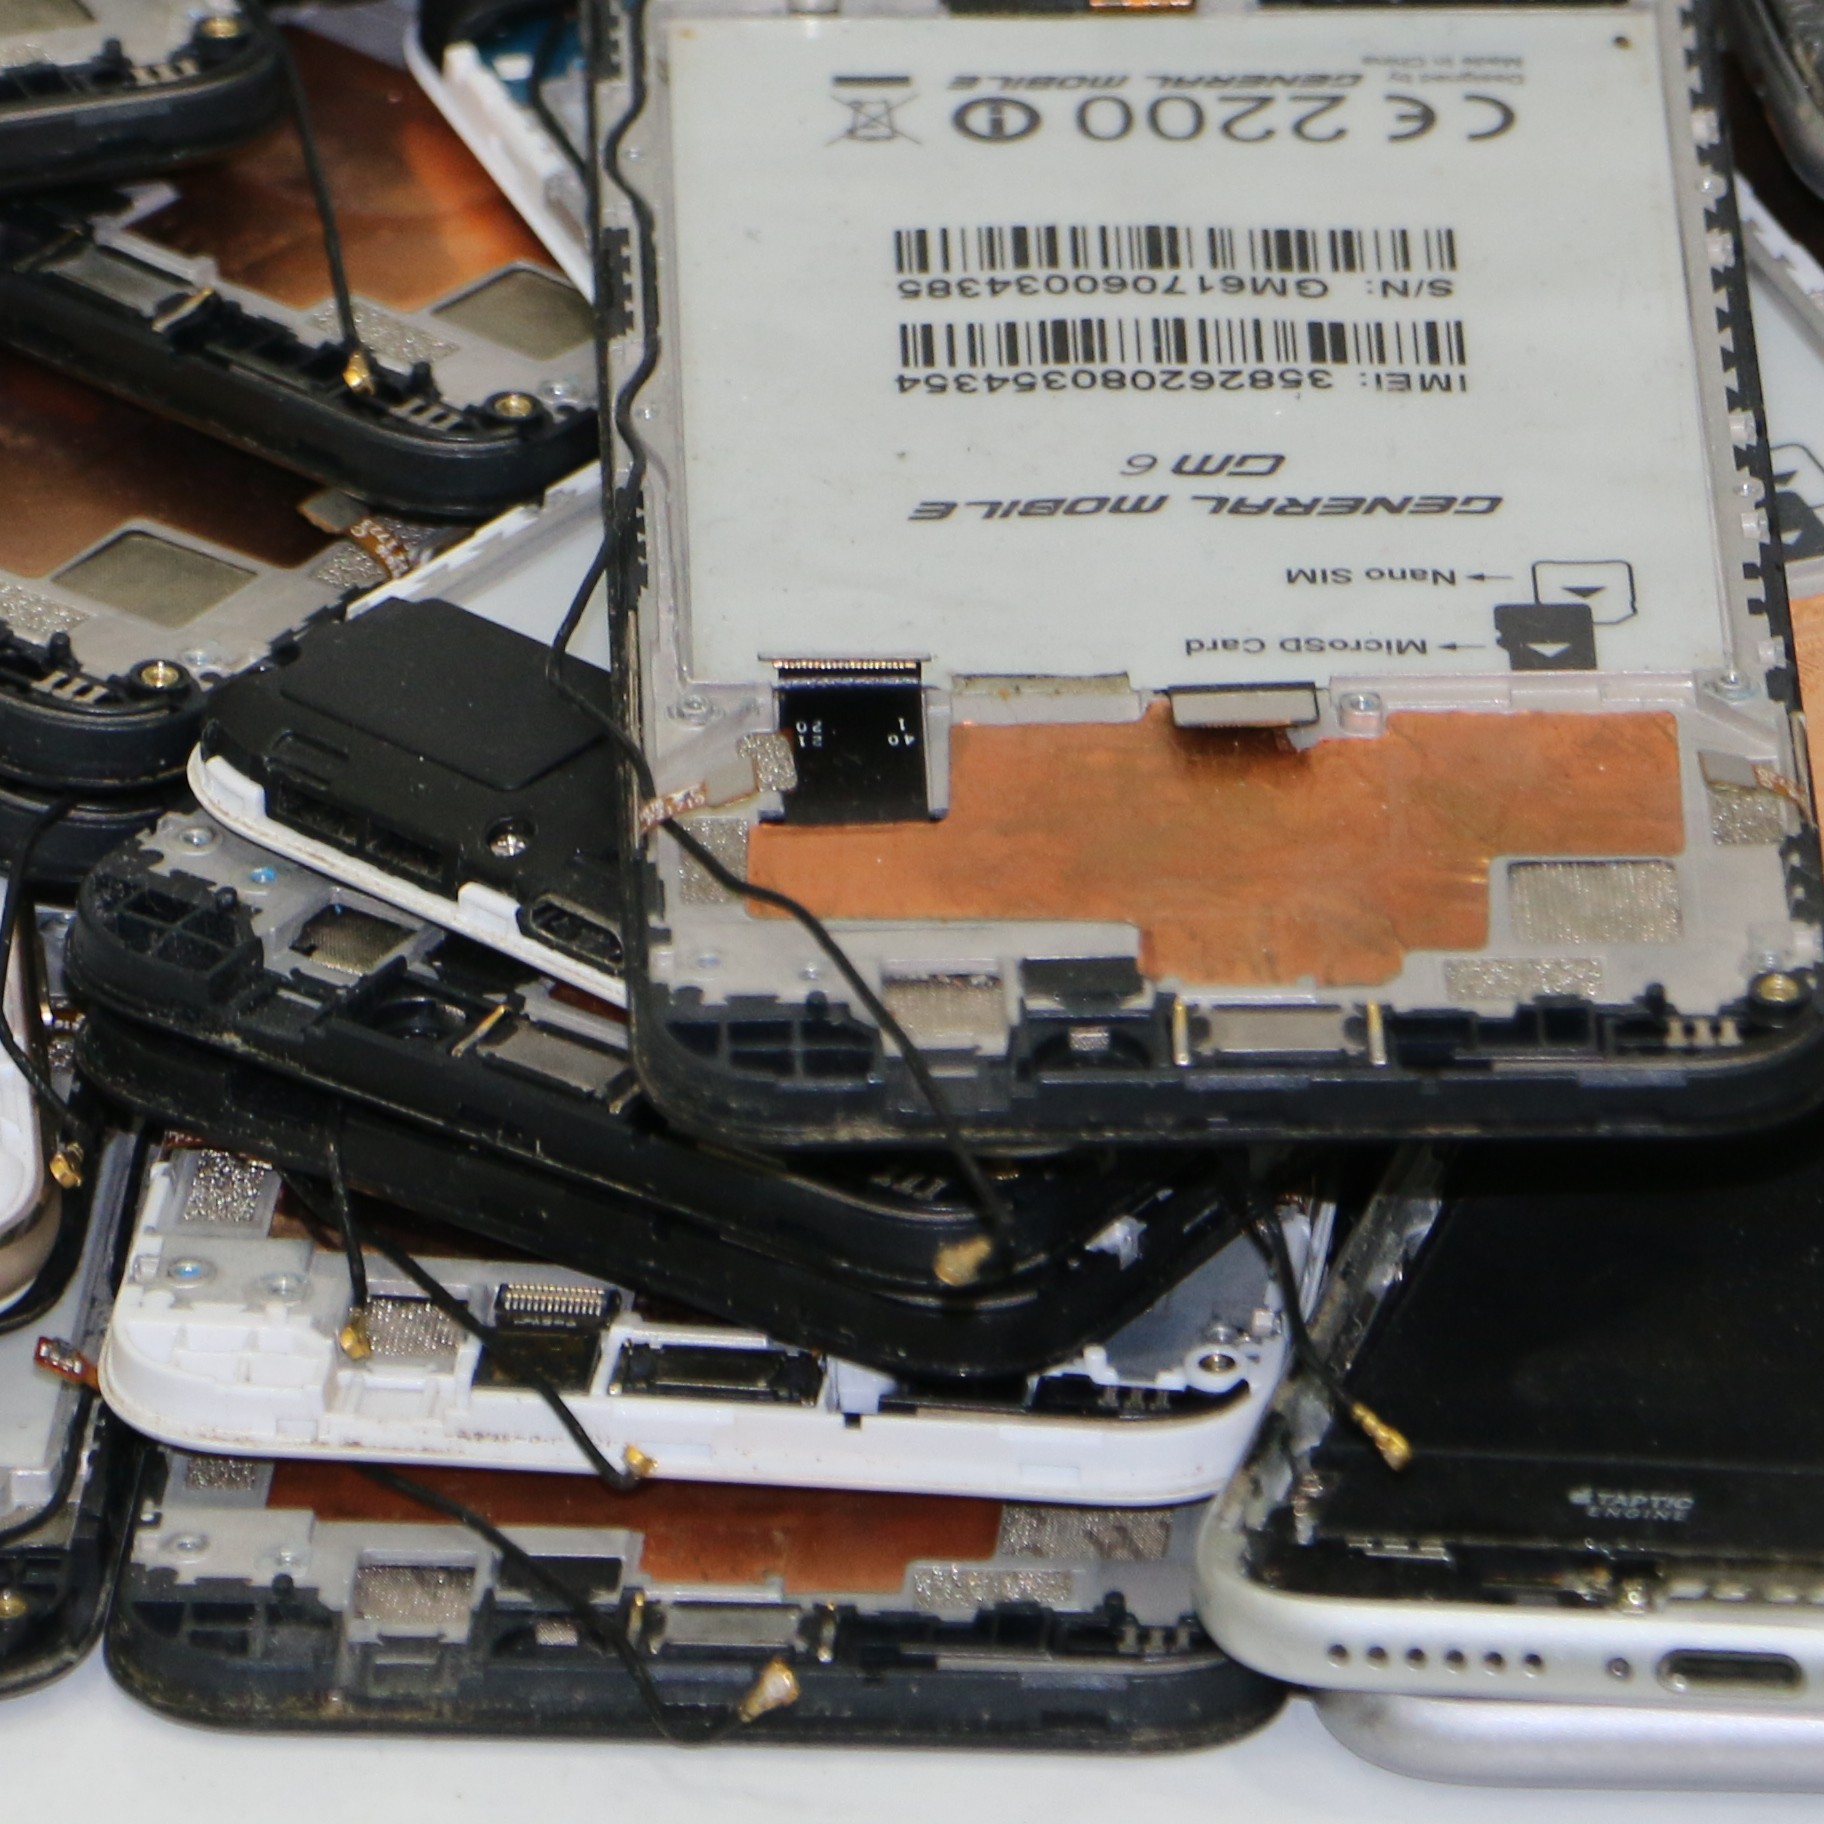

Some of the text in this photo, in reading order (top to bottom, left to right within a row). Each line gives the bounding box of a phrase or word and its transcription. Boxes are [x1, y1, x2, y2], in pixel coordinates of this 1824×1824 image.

[1074, 93, 1349, 144] 2200
[896, 275, 1453, 299] S/N: GM617060034385
[894, 367, 1467, 395] IMEI: 358262080354354
[1173, 454, 1286, 477] GM
[909, 495, 1503, 521] GENERAL MOBILE
[1284, 567, 1456, 586] Nano SIM
[1184, 636, 1427, 657] MicroSD Card
[1596, 1492, 1694, 1510] TAPTIC
[1587, 1507, 1688, 1522] ENGINE
